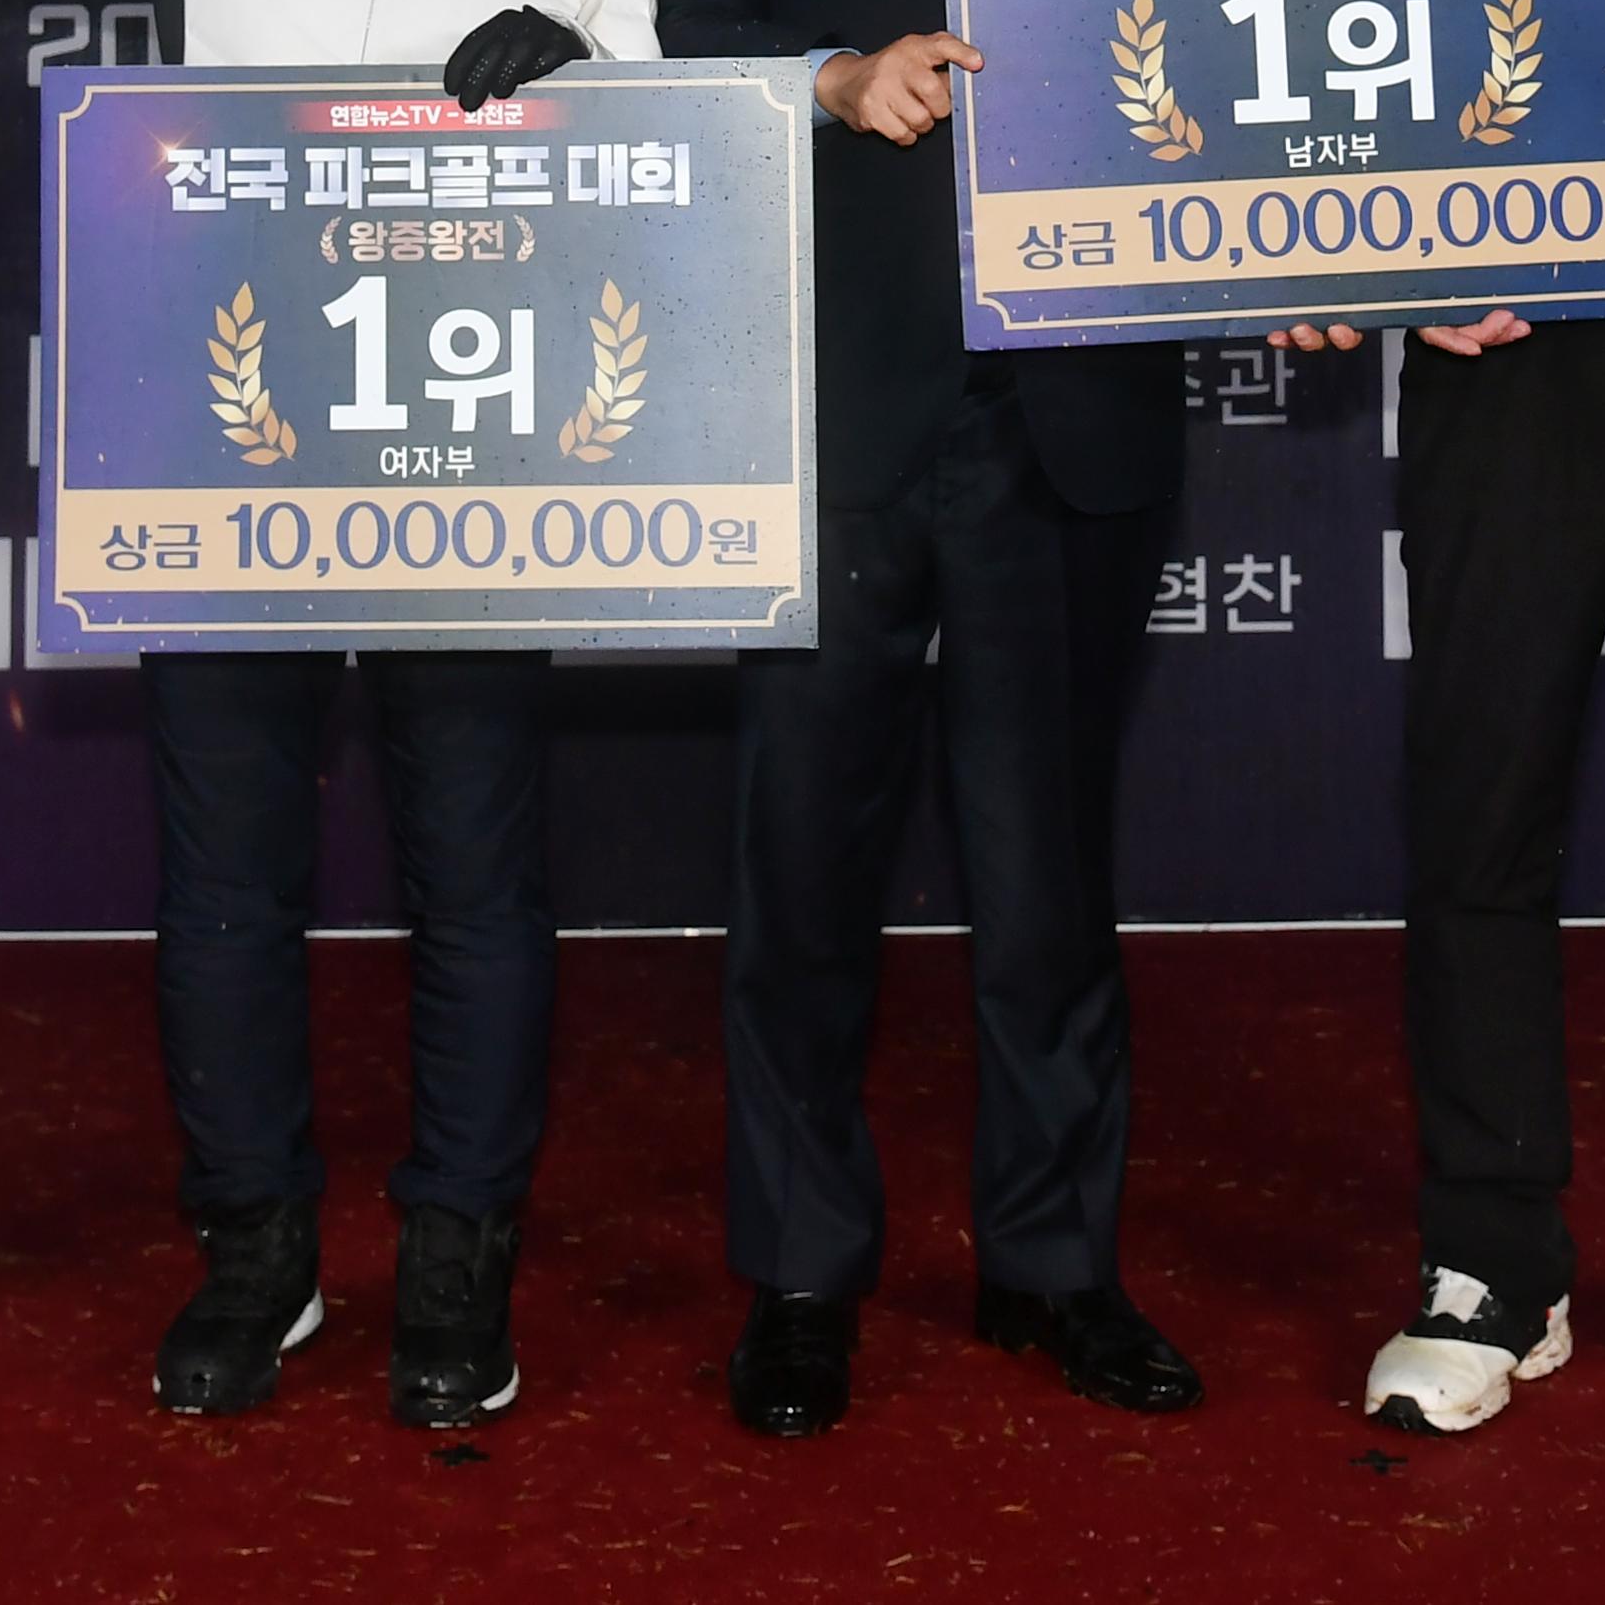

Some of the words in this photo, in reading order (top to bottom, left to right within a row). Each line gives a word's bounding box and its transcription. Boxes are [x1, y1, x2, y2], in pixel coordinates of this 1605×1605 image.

[330, 103, 441, 129] 연합뉴스TV
[464, 103, 524, 128] 화천군
[164, 147, 289, 212] 전국
[304, 144, 553, 209] 파크골프
[566, 141, 691, 206] 대회
[1284, 132, 1379, 168] 남자부
[348, 219, 505, 262] 왕중왕전
[1016, 221, 1116, 270] 상금
[321, 275, 536, 436] 1위
[1184, 349, 1295, 425] 관
[379, 445, 477, 480] 여자부
[99, 523, 202, 571] 상금
[226, 498, 758, 578] 10,000,000원
[1146, 553, 1302, 633] 협찬
